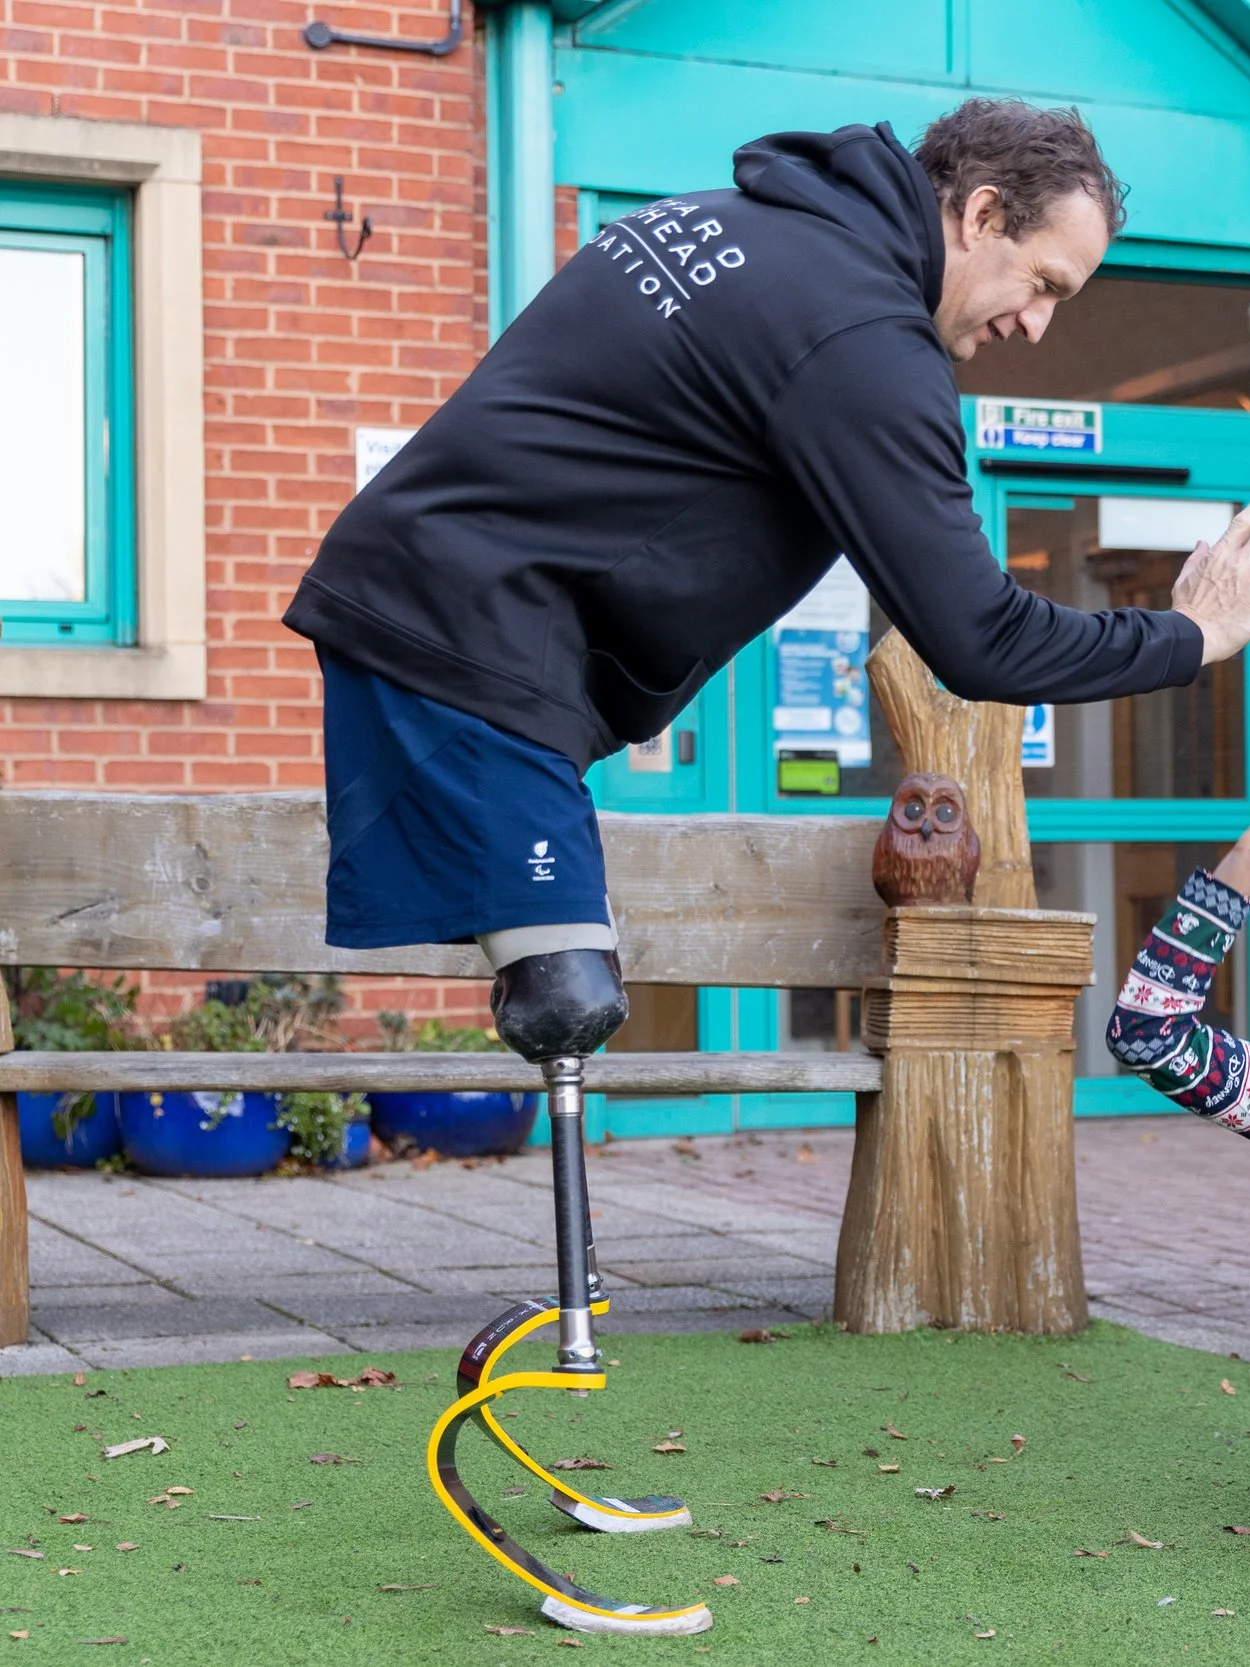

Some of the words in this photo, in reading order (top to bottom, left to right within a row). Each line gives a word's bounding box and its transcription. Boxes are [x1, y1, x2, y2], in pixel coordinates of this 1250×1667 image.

[1013, 407, 1049, 427] Fire
[1051, 411, 1085, 429] exit
[1206, 1054, 1245, 1108] Disney
